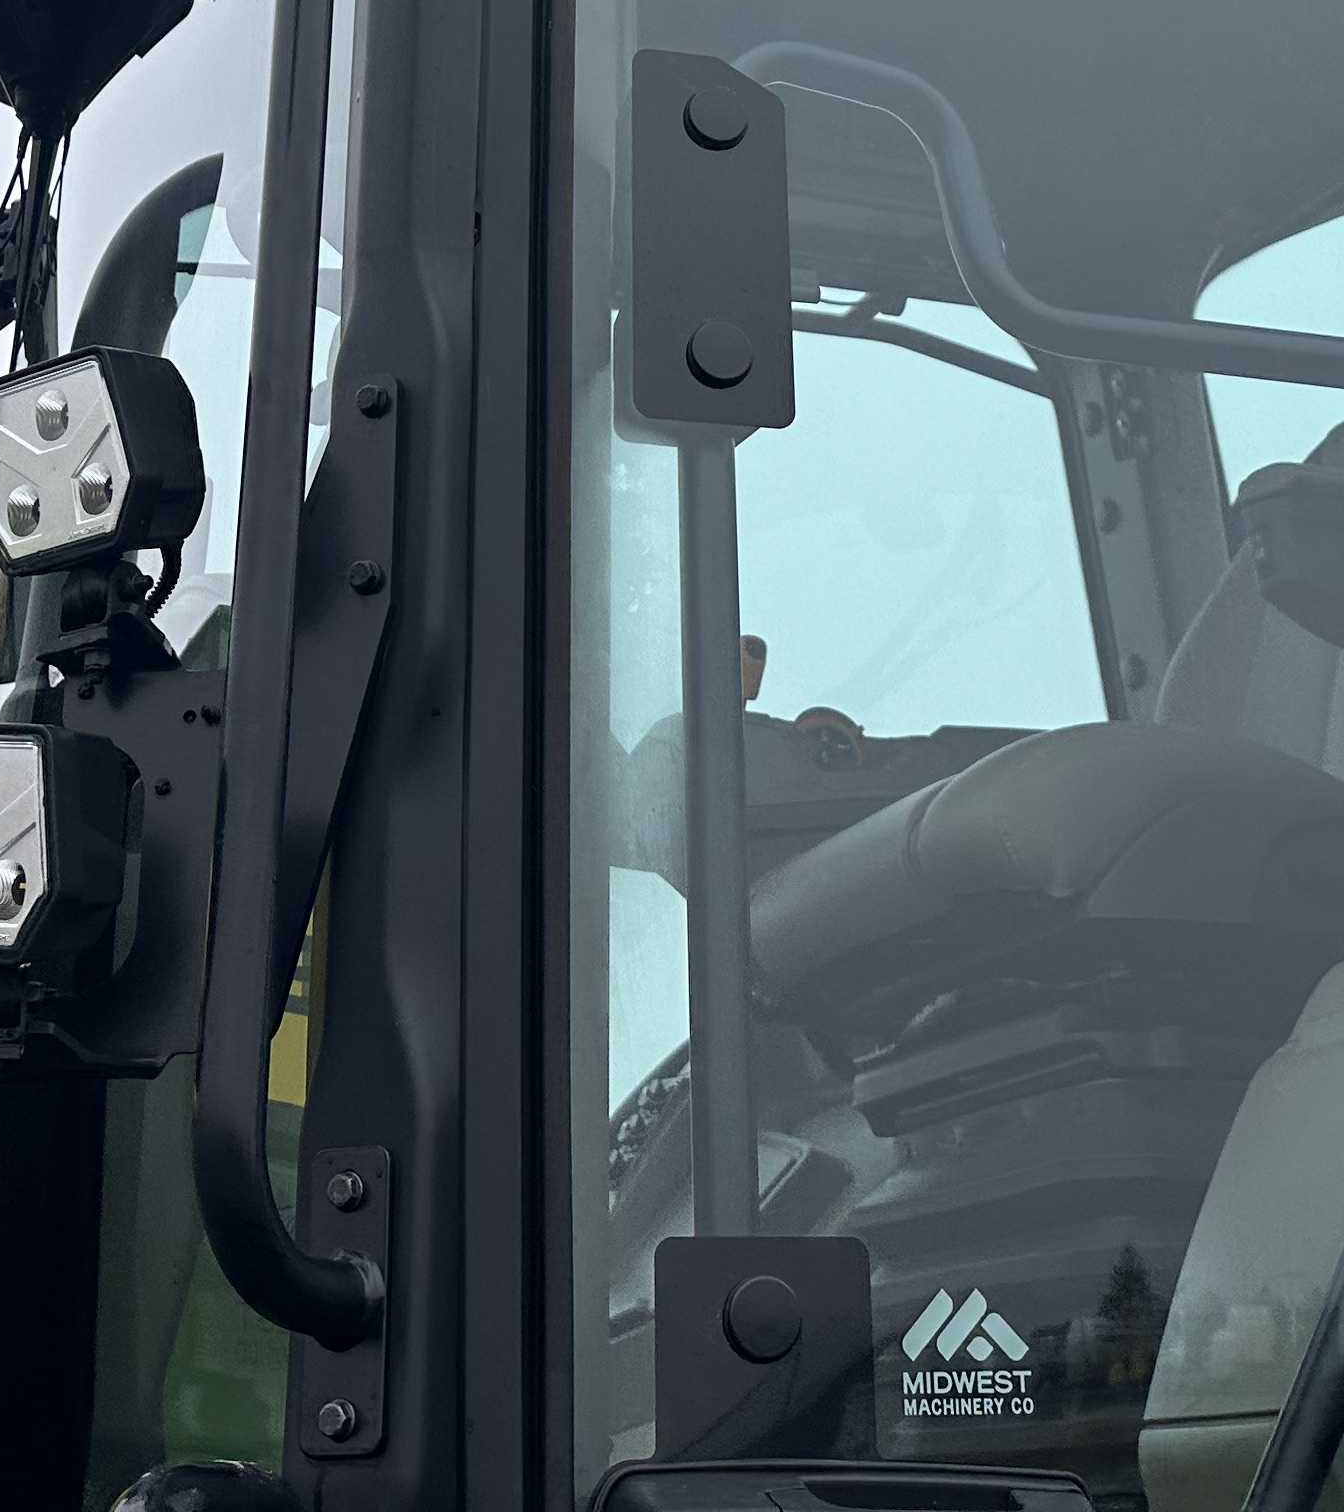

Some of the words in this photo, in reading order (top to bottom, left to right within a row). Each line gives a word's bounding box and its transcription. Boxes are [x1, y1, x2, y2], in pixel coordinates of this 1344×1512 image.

[902, 1369, 1032, 1395] MIDWEST
[903, 1397, 1004, 1416] MACHINERY
[1010, 1397, 1035, 1415] CO
